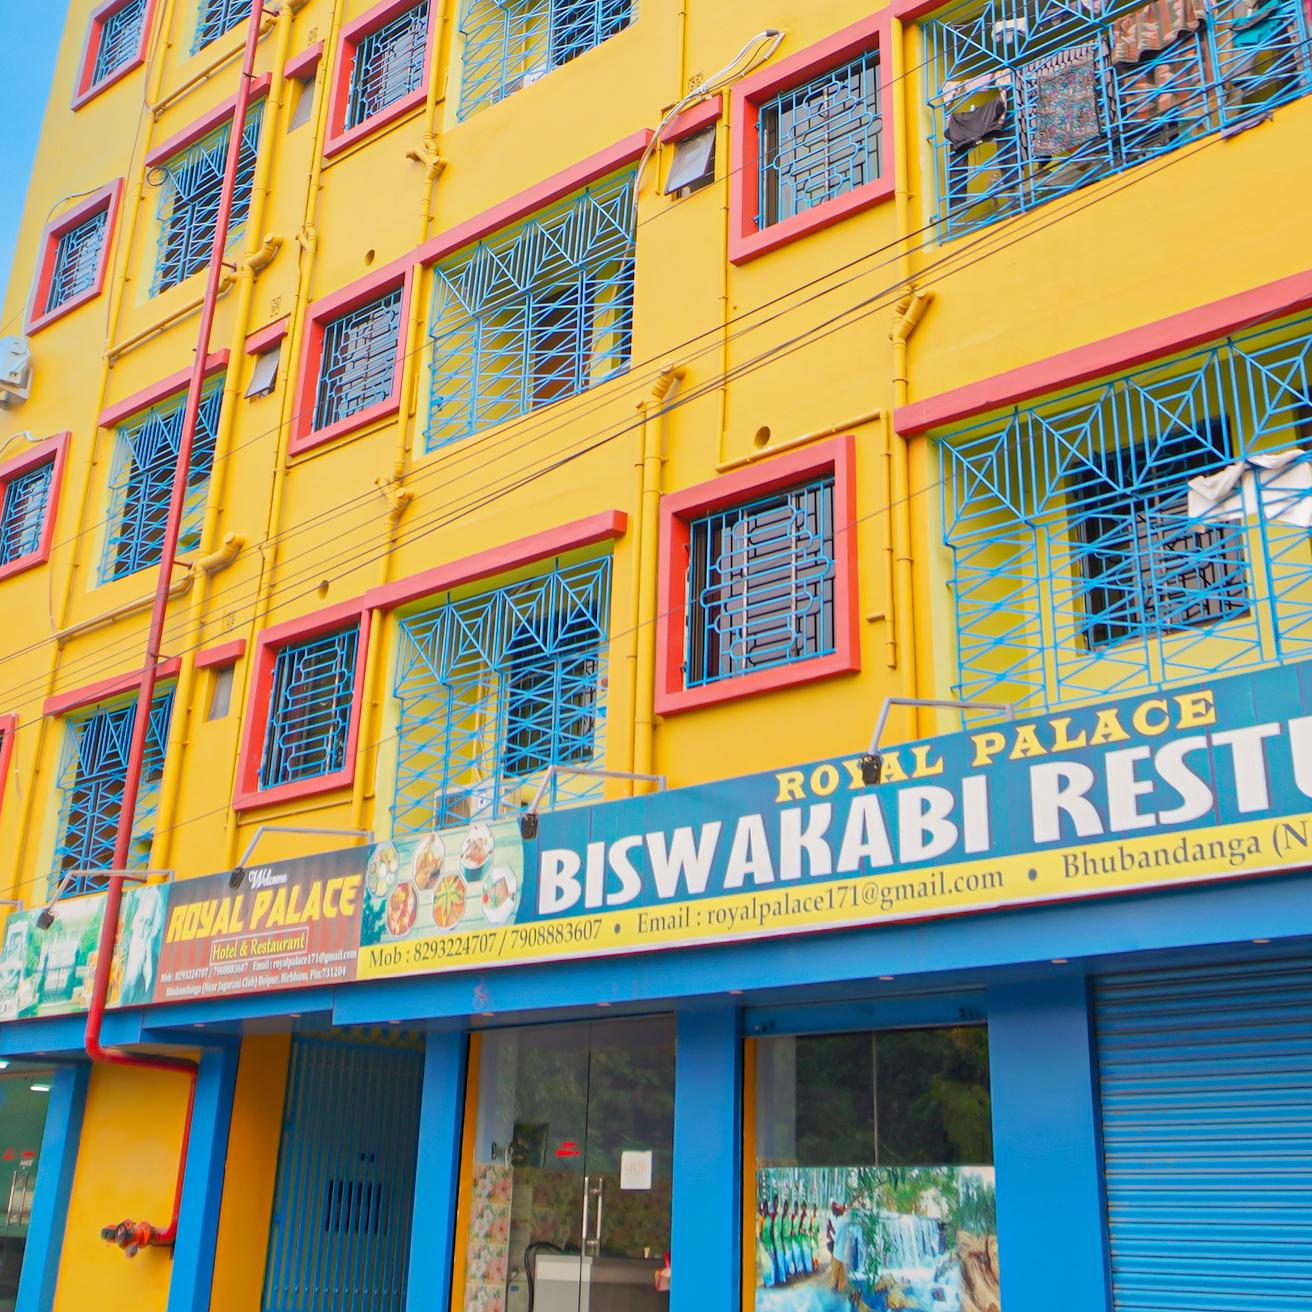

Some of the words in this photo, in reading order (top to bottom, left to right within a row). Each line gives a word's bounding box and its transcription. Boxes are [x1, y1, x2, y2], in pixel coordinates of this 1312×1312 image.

[775, 745, 944, 803] ROYAL
[971, 690, 1217, 767] PALACE
[248, 868, 288, 889] Welcome
[538, 775, 990, 915] BISWAKABI
[166, 894, 244, 944] ROYAL
[249, 874, 362, 931] PALACE
[212, 938, 237, 961] Hotel
[239, 940, 248, 957] &
[250, 932, 306, 956] Restaurant
[369, 947, 401, 968] Mob
[413, 932, 497, 961] 8293224707
[510, 918, 603, 949] 7908883607
[637, 906, 690, 933] Email
[707, 868, 1004, 930] royalpalace171@gmail.com
[1062, 836, 1262, 879] Bhubandanga
